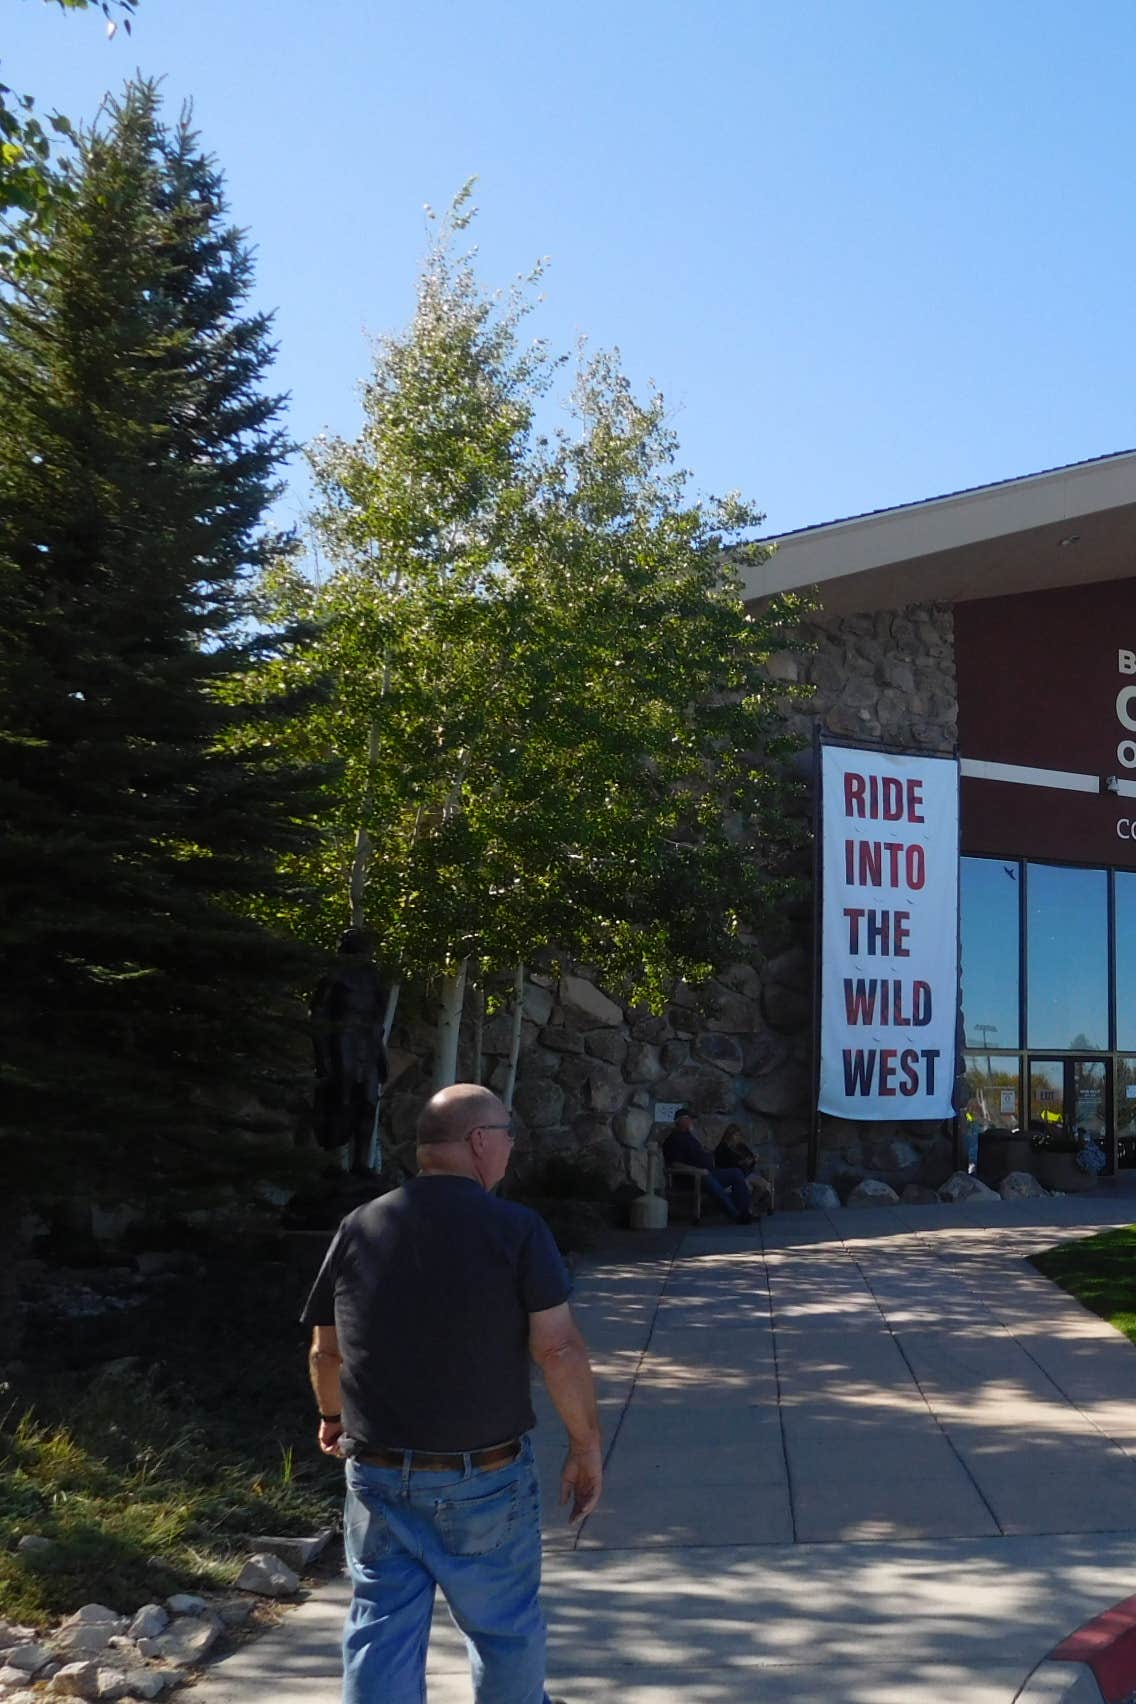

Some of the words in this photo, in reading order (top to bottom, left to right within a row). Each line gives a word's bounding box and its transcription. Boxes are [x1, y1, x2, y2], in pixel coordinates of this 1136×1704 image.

[843, 772, 925, 824] RIDE
[844, 839, 926, 890] INTO
[843, 908, 910, 957] THE
[843, 978, 932, 1027] WILD
[842, 1049, 940, 1096] WEST
